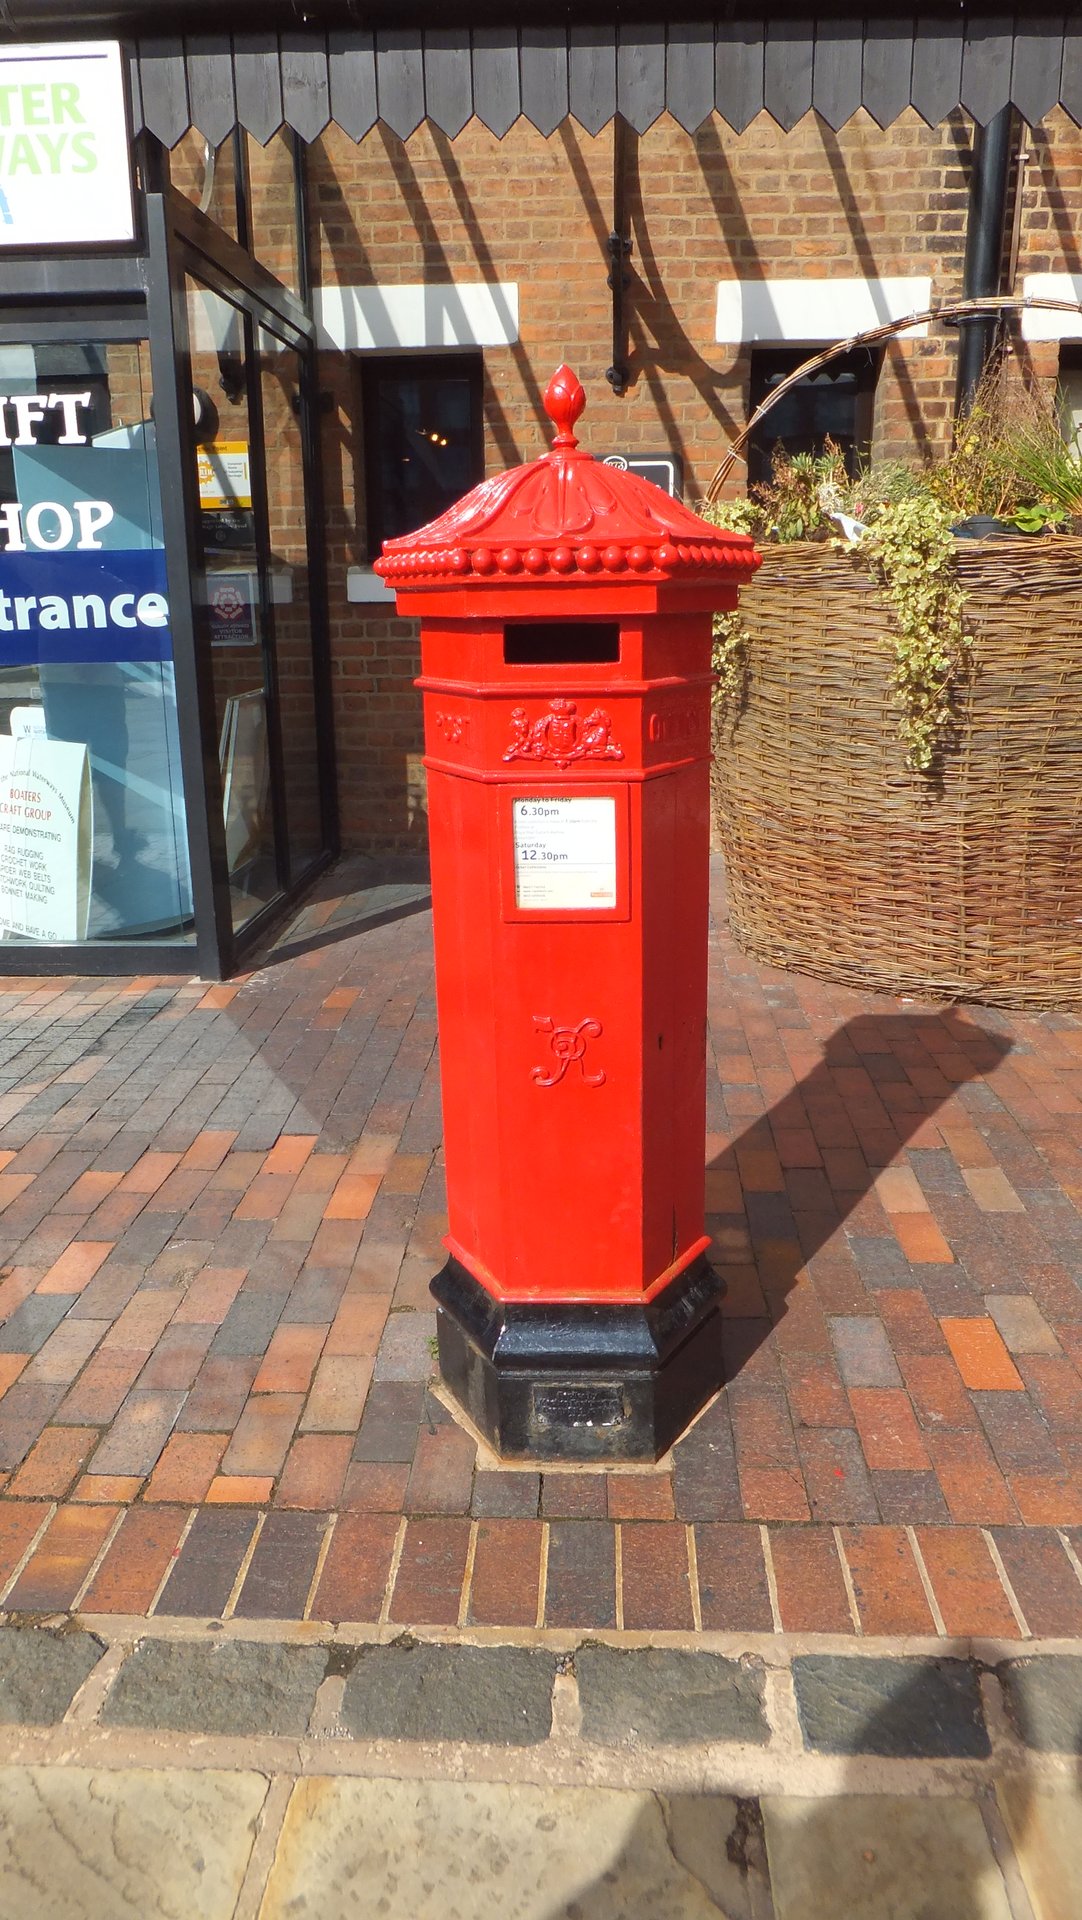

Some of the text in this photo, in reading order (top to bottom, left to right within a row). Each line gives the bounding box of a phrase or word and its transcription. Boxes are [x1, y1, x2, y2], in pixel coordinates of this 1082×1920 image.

[0, 589, 170, 631] trance
[9, 787, 42, 804] BOATERS
[9, 768, 31, 778] National
[32, 770, 59, 794] Waterways
[57, 791, 76, 824] Museum
[24, 806, 52, 822] GROUP
[520, 805, 560, 817] 6.30pm
[12, 825, 62, 843] DEMONSTRATING
[4, 844, 44, 861] RAG RUGGING
[521, 850, 568, 861] 12.30pm
[0, 854, 48, 872] CROCHET WORK
[18, 869, 32, 879] WEB
[33, 871, 52, 884] BELTS
[1, 885, 49, 905] BONNET MAKING
[28, 881, 56, 896] QUILTING
[12, 921, 24, 932] AND
[25, 926, 40, 937] HAVE
[41, 929, 47, 938] A
[47, 931, 58, 941] GO
